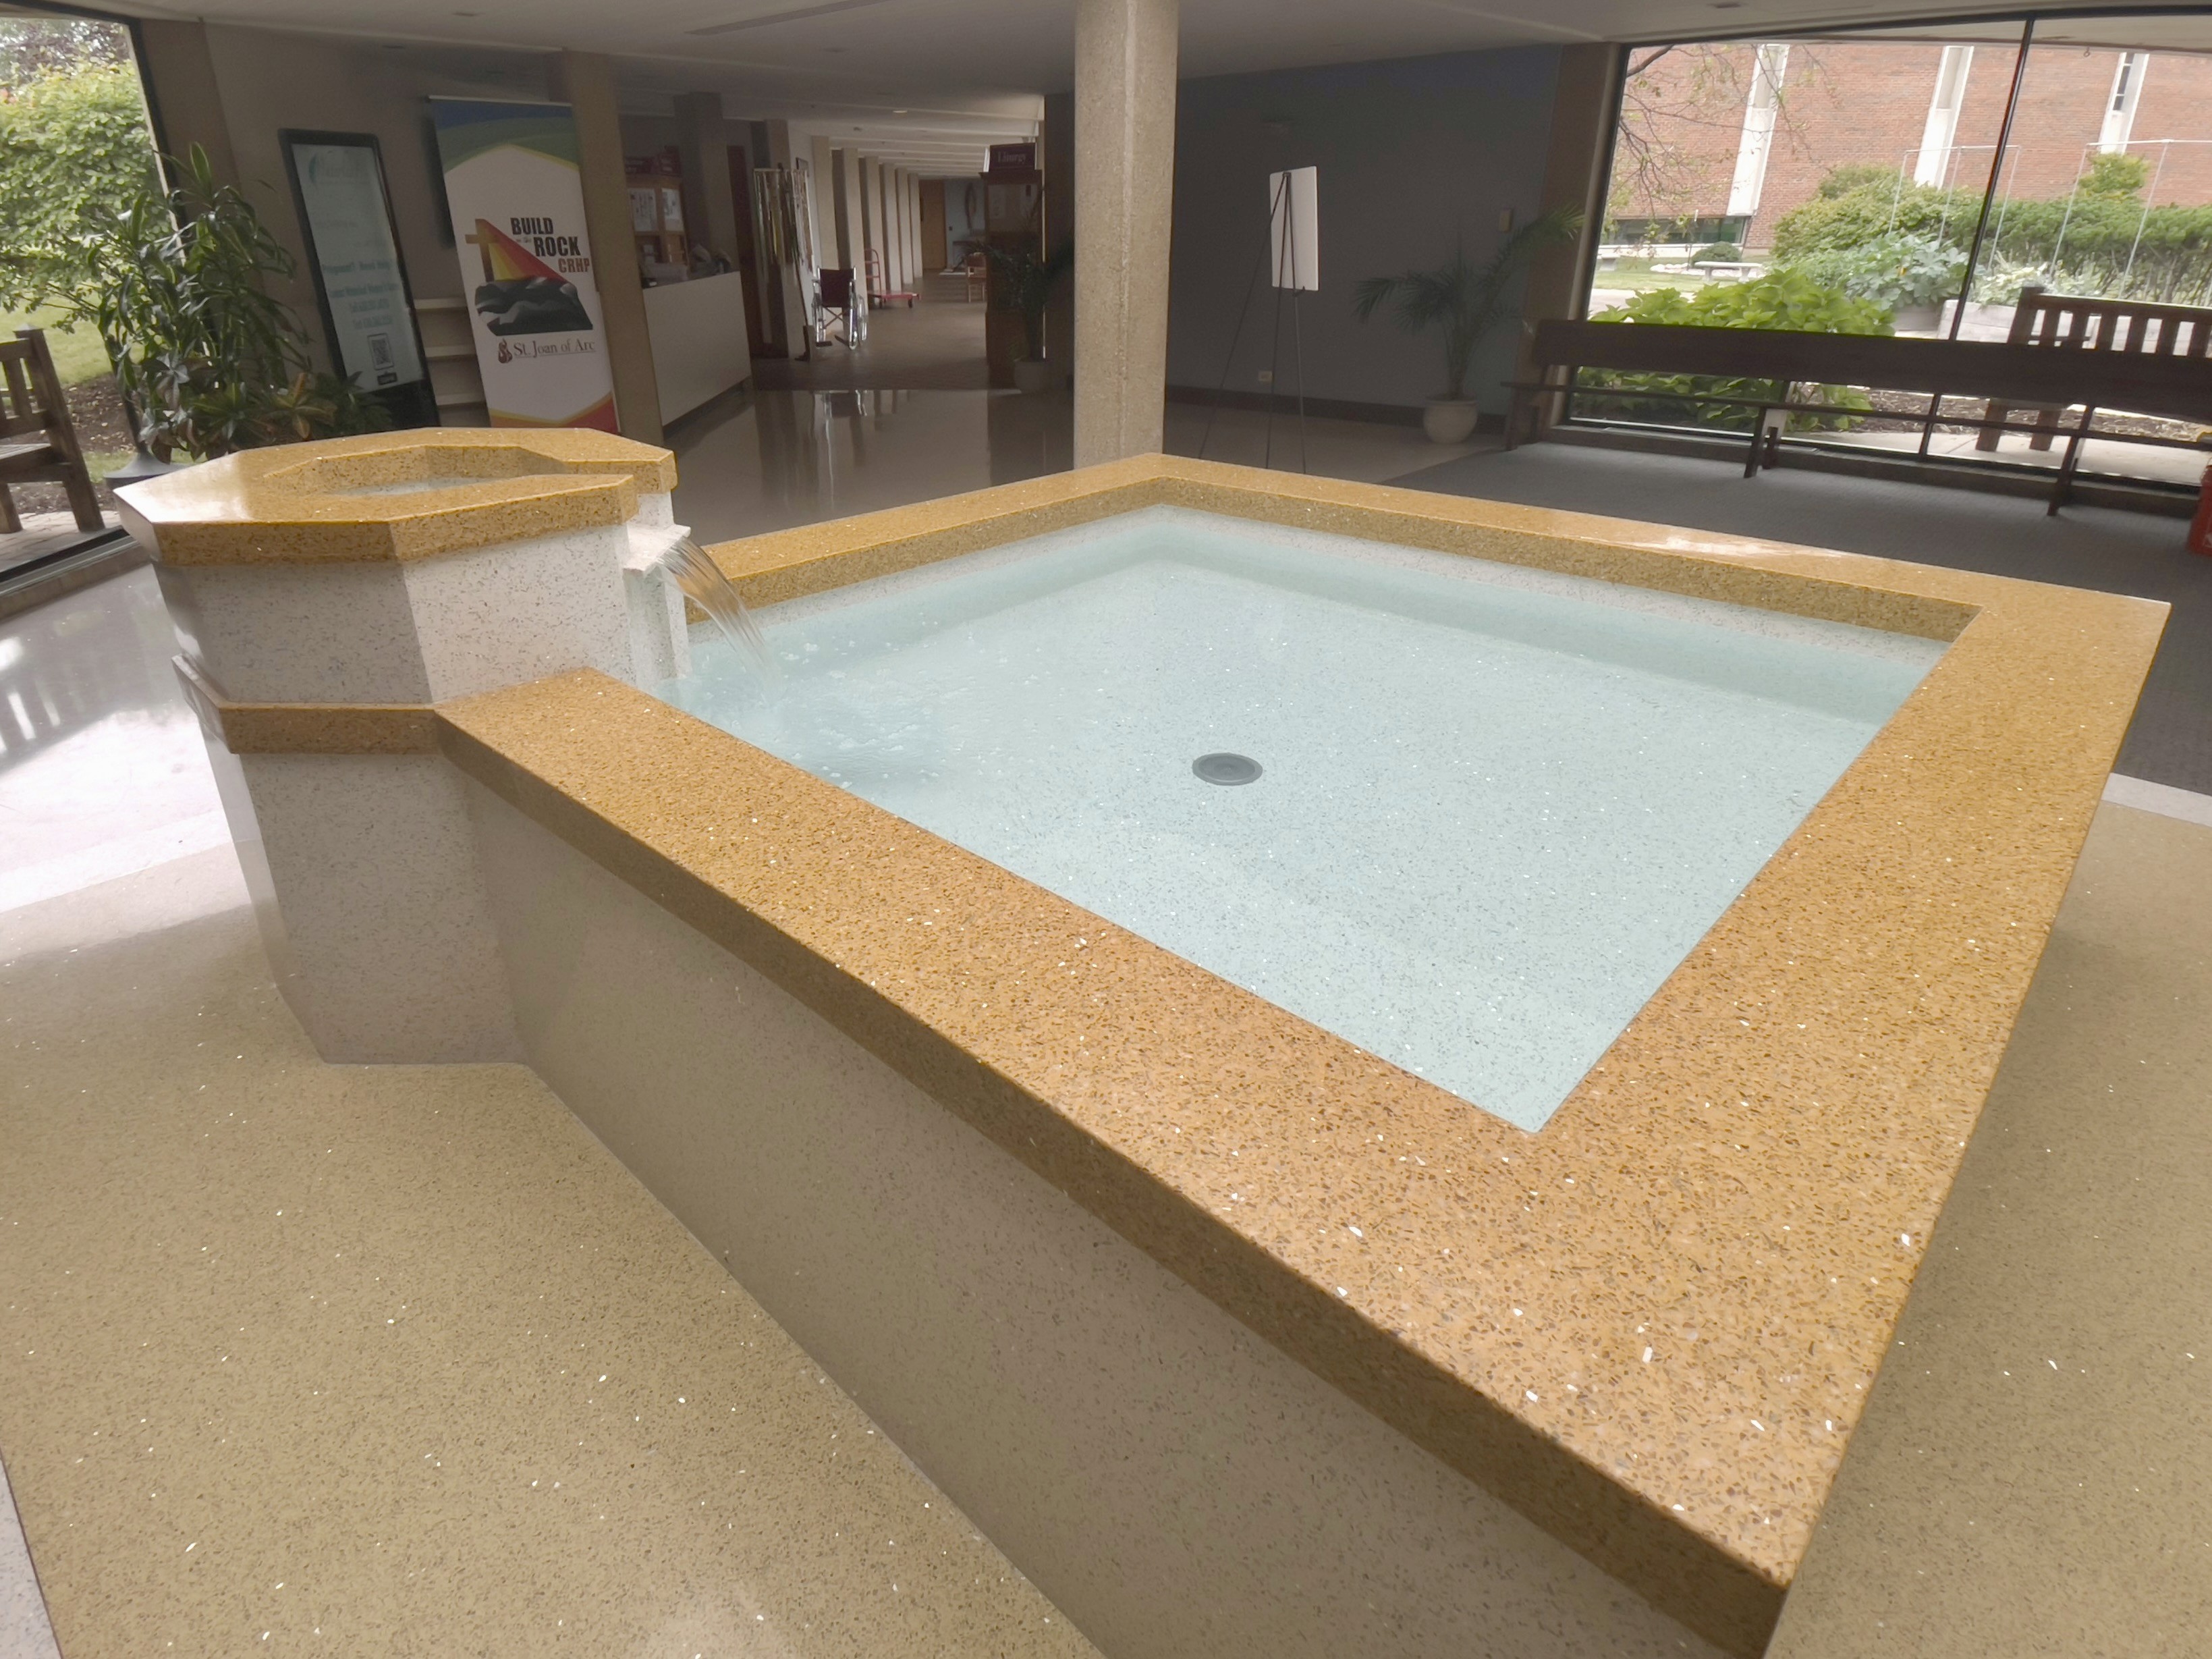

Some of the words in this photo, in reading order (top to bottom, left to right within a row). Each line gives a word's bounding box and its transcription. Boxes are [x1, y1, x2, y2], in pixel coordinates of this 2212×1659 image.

[510, 217, 554, 235] BUILD
[533, 236, 581, 256] ROCK
[558, 258, 590, 273] CRHP
[514, 342, 530, 356] St.
[532, 340, 558, 358] Joan
[561, 339, 572, 352] of
[576, 338, 595, 351] Arc
